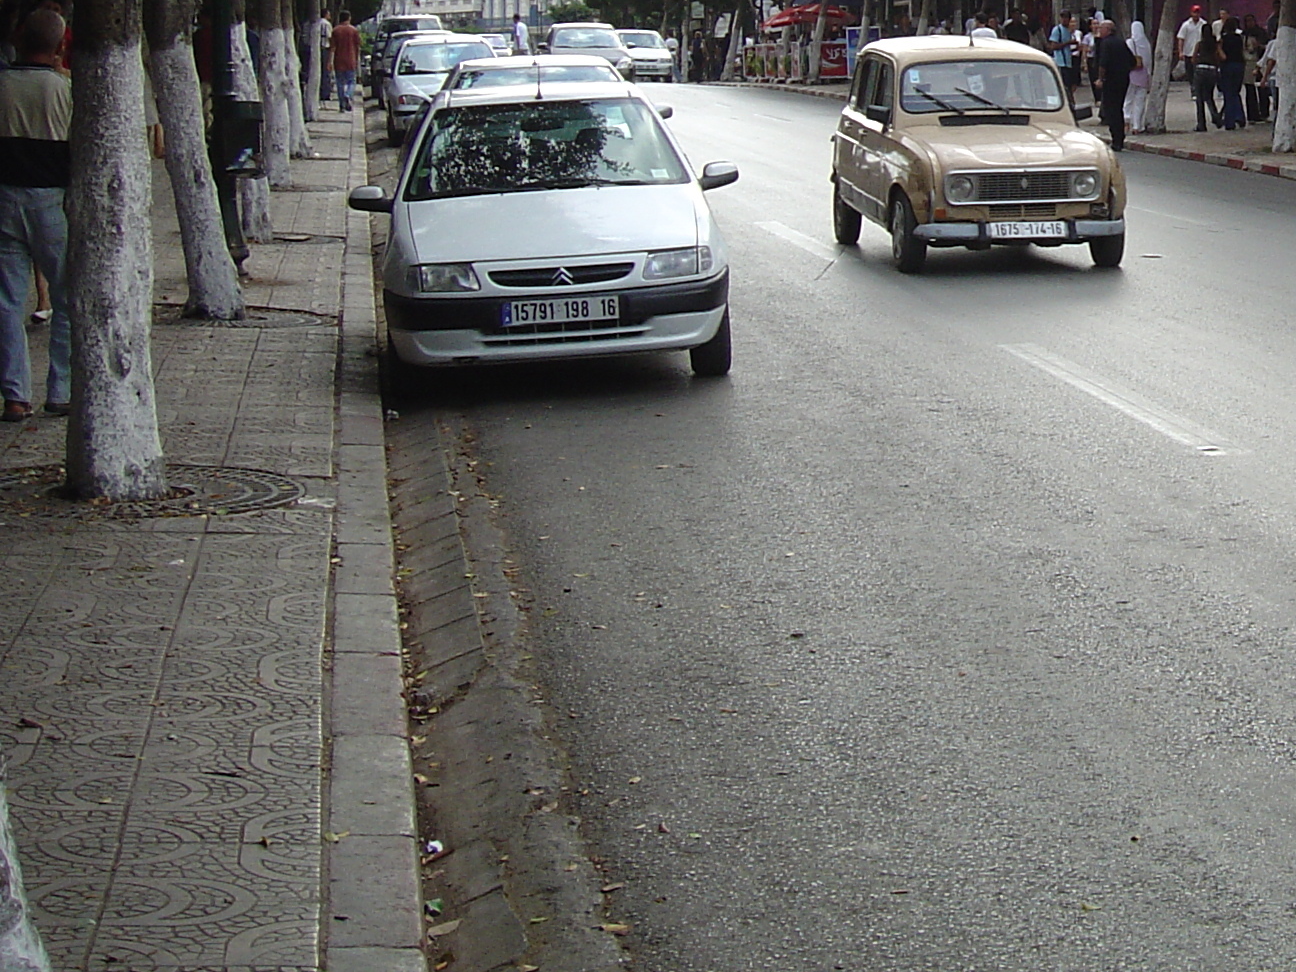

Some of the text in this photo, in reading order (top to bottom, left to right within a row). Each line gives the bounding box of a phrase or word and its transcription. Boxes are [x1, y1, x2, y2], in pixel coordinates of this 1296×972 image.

[514, 302, 555, 321] 15791
[564, 300, 589, 318] 198
[601, 299, 616, 316] 16
